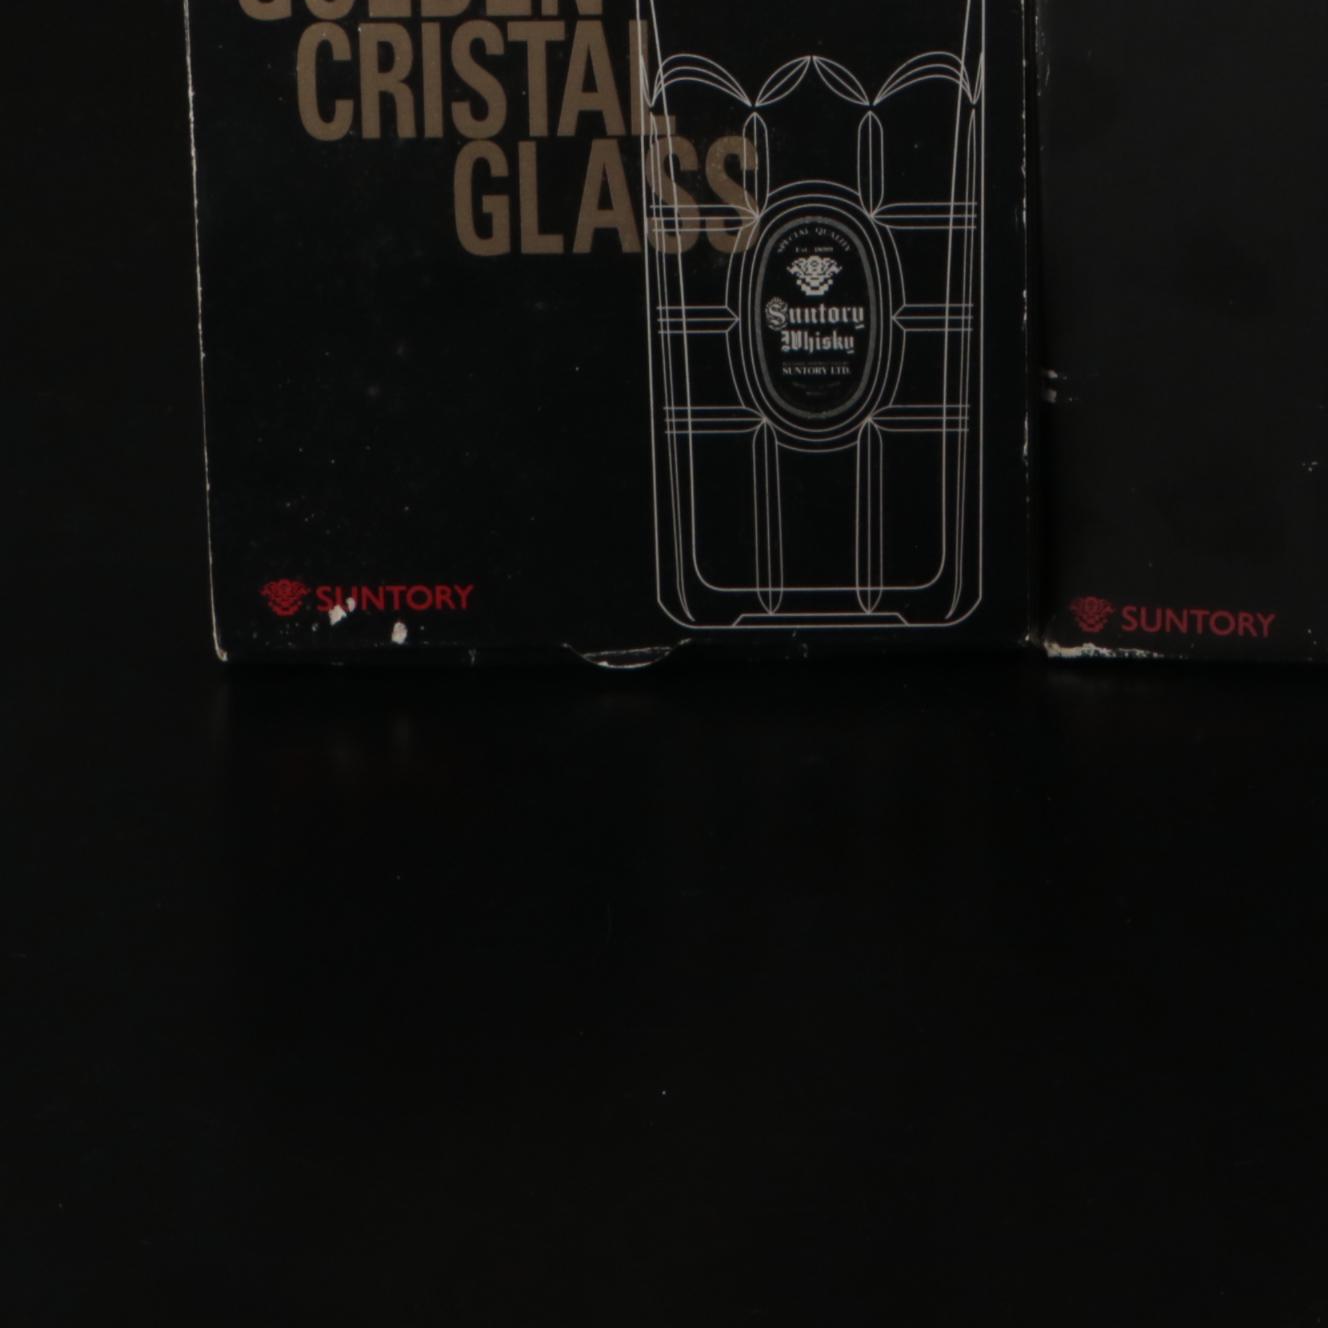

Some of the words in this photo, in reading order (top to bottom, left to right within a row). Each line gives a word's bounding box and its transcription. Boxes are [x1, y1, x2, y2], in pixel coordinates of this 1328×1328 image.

[297, 19, 677, 141] CRISTAL
[453, 135, 760, 257] GLASS
[765, 296, 865, 331] Suntory
[781, 330, 854, 354] Whisky
[315, 583, 476, 612] SUNTORY
[1121, 605, 1277, 638] SUNTORY
